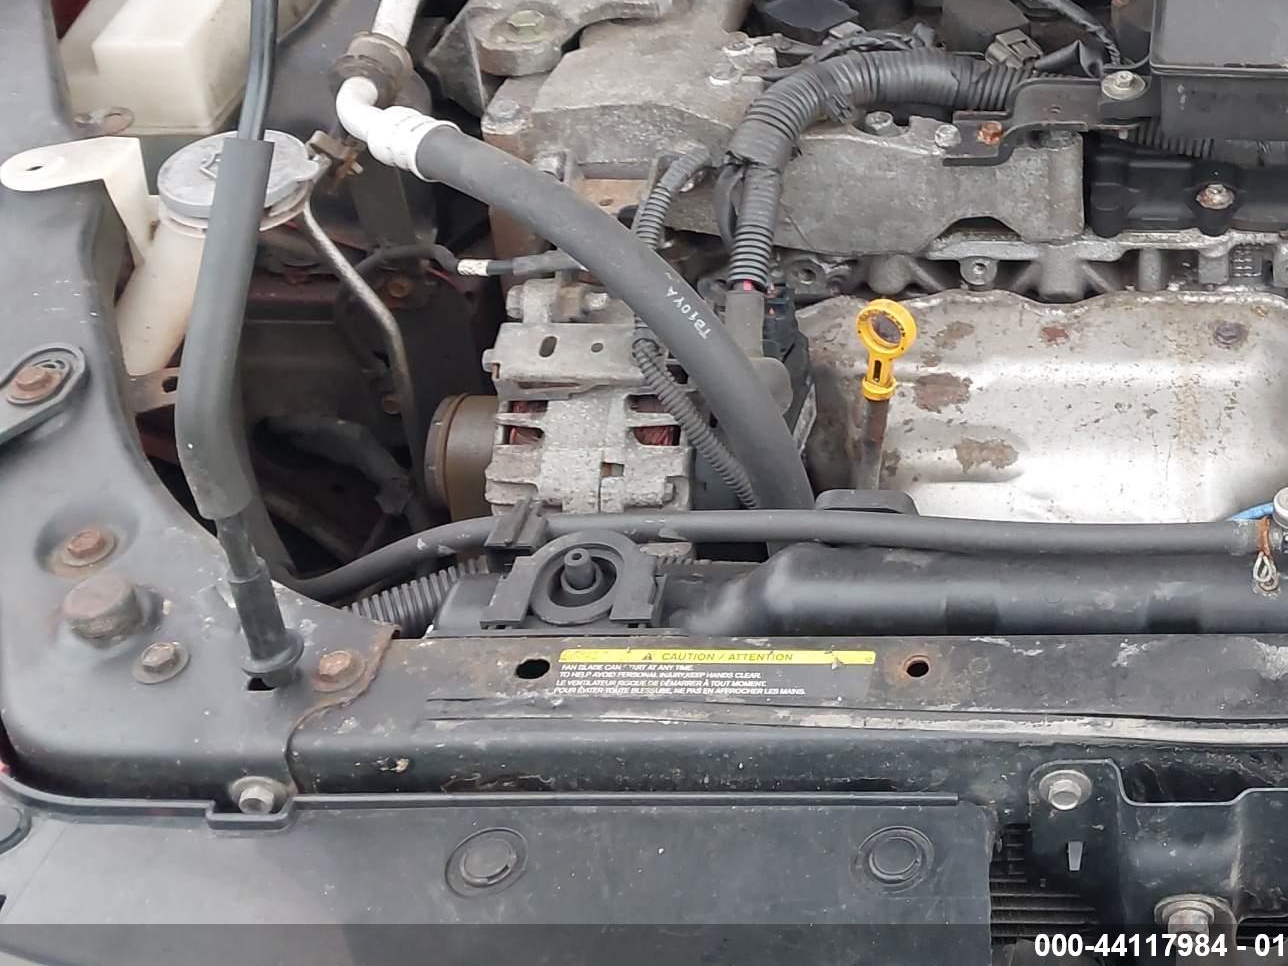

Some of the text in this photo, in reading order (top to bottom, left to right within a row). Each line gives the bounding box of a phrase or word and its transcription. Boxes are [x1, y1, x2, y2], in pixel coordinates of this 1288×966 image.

[661, 652, 793, 662] CAUTION / ATTENTION
